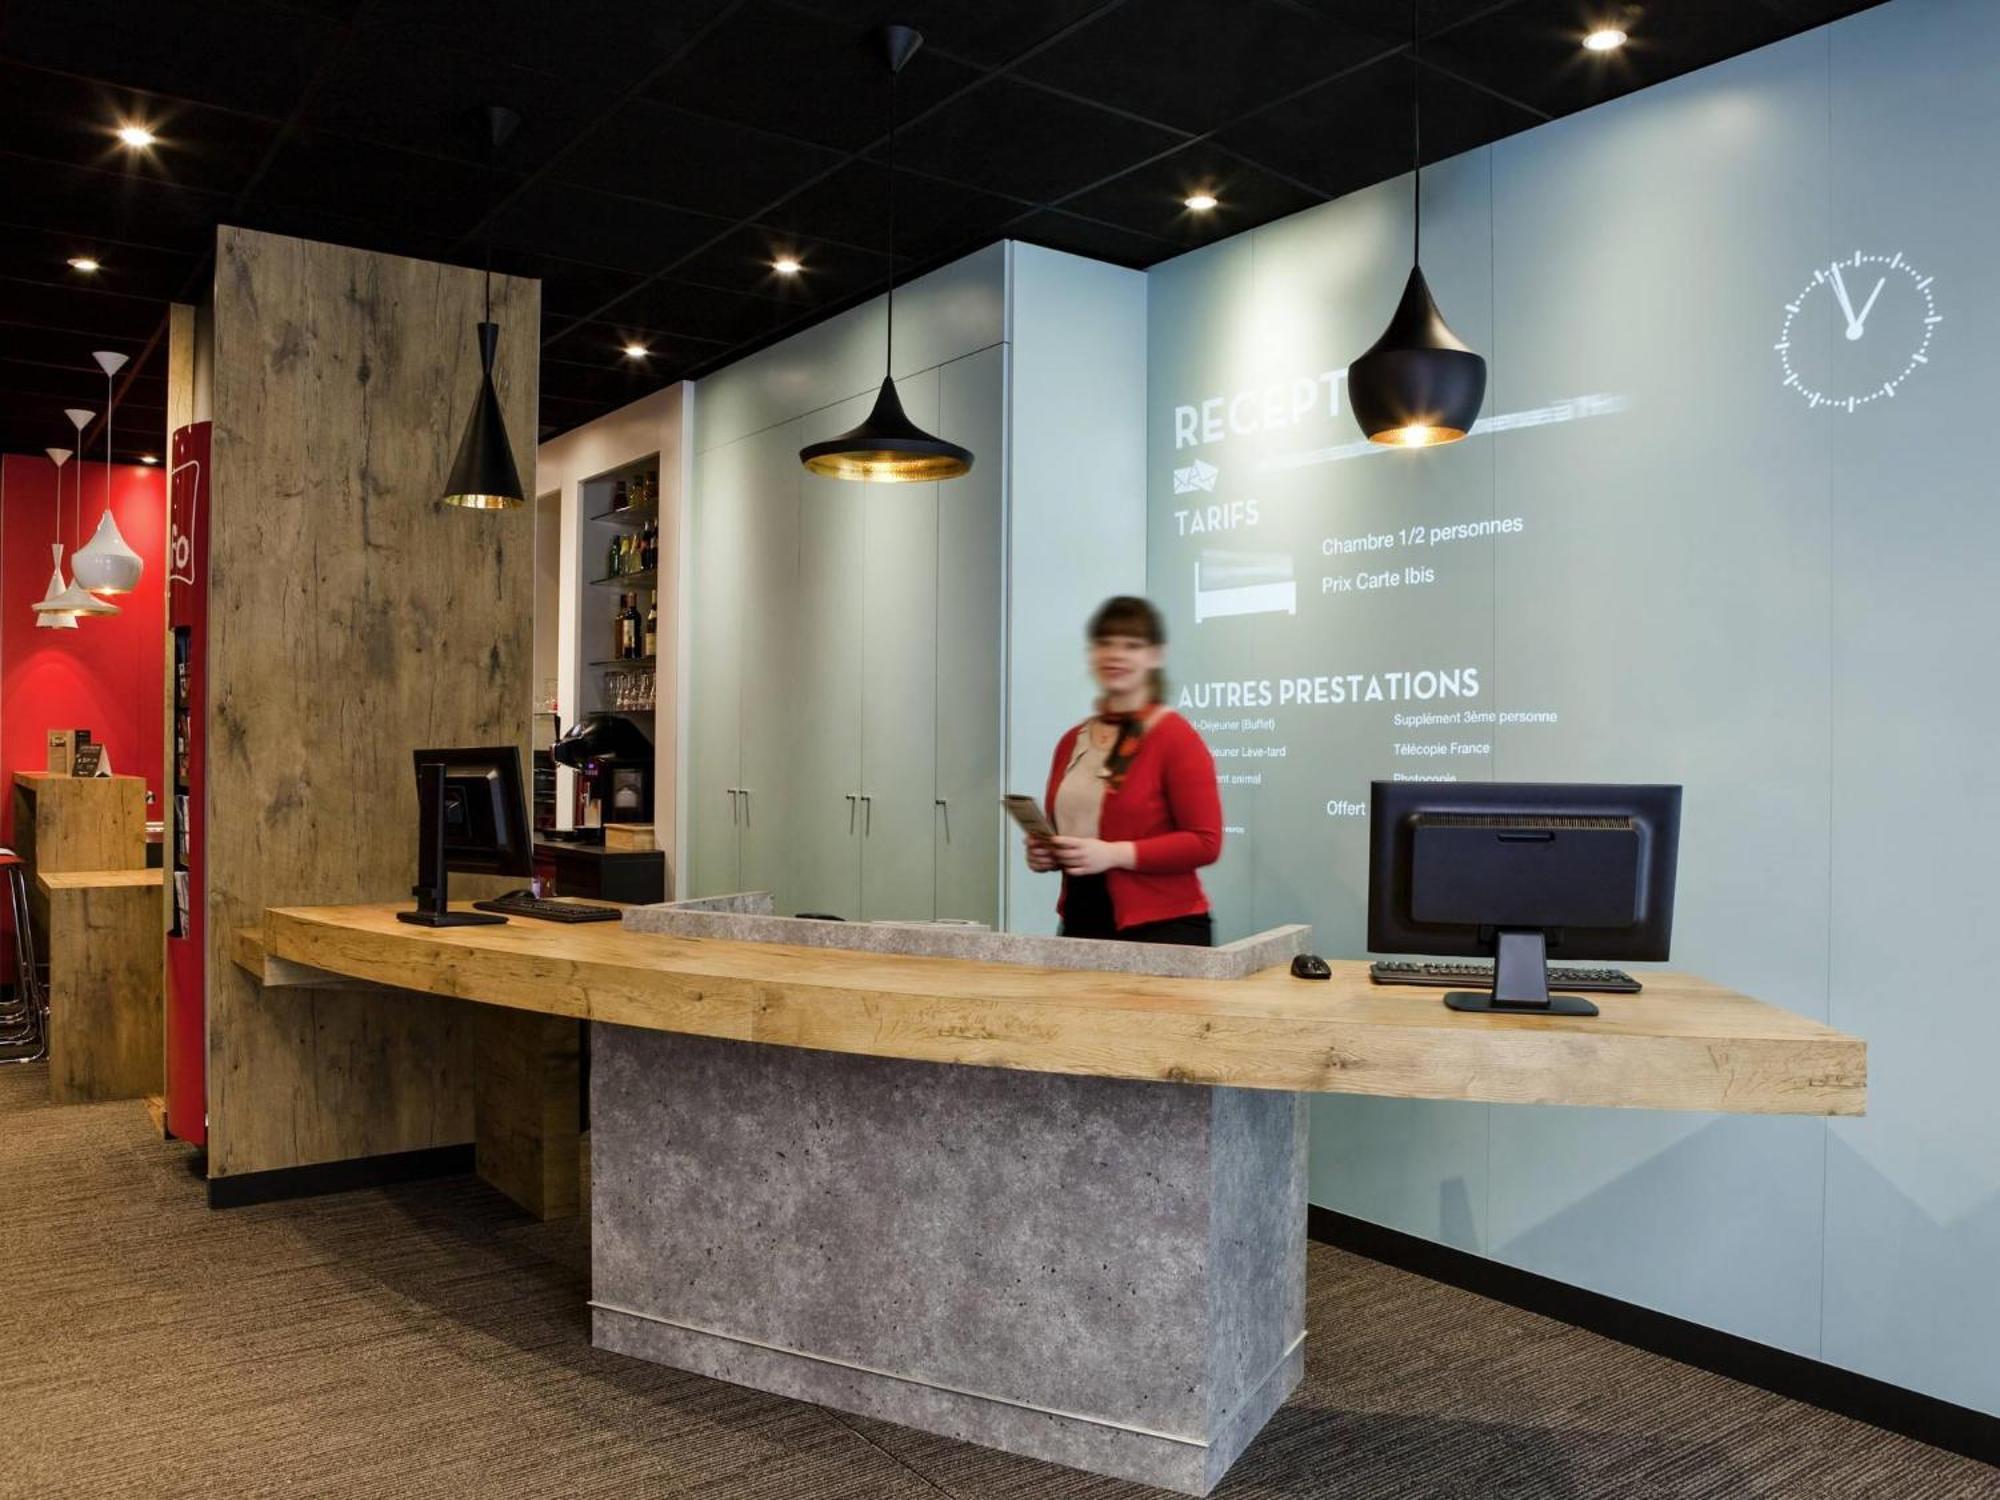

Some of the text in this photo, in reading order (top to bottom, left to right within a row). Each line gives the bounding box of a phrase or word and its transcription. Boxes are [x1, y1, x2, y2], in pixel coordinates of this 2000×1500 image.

[1174, 367, 1348, 449] RECEPT
[1175, 499, 1260, 536] TARIFS
[1321, 517, 1524, 556] Chambre 1/2 personnes
[1321, 566, 1435, 594] Prix Carte Ibis
[1178, 668, 1480, 709] AUTRES PRESTATIONS
[1393, 710, 1558, 728] Supplément 3ème personne
[1393, 741, 1491, 757] Télécopie France
[1231, 773, 1262, 785] animal
[1326, 800, 1366, 817] Offert
